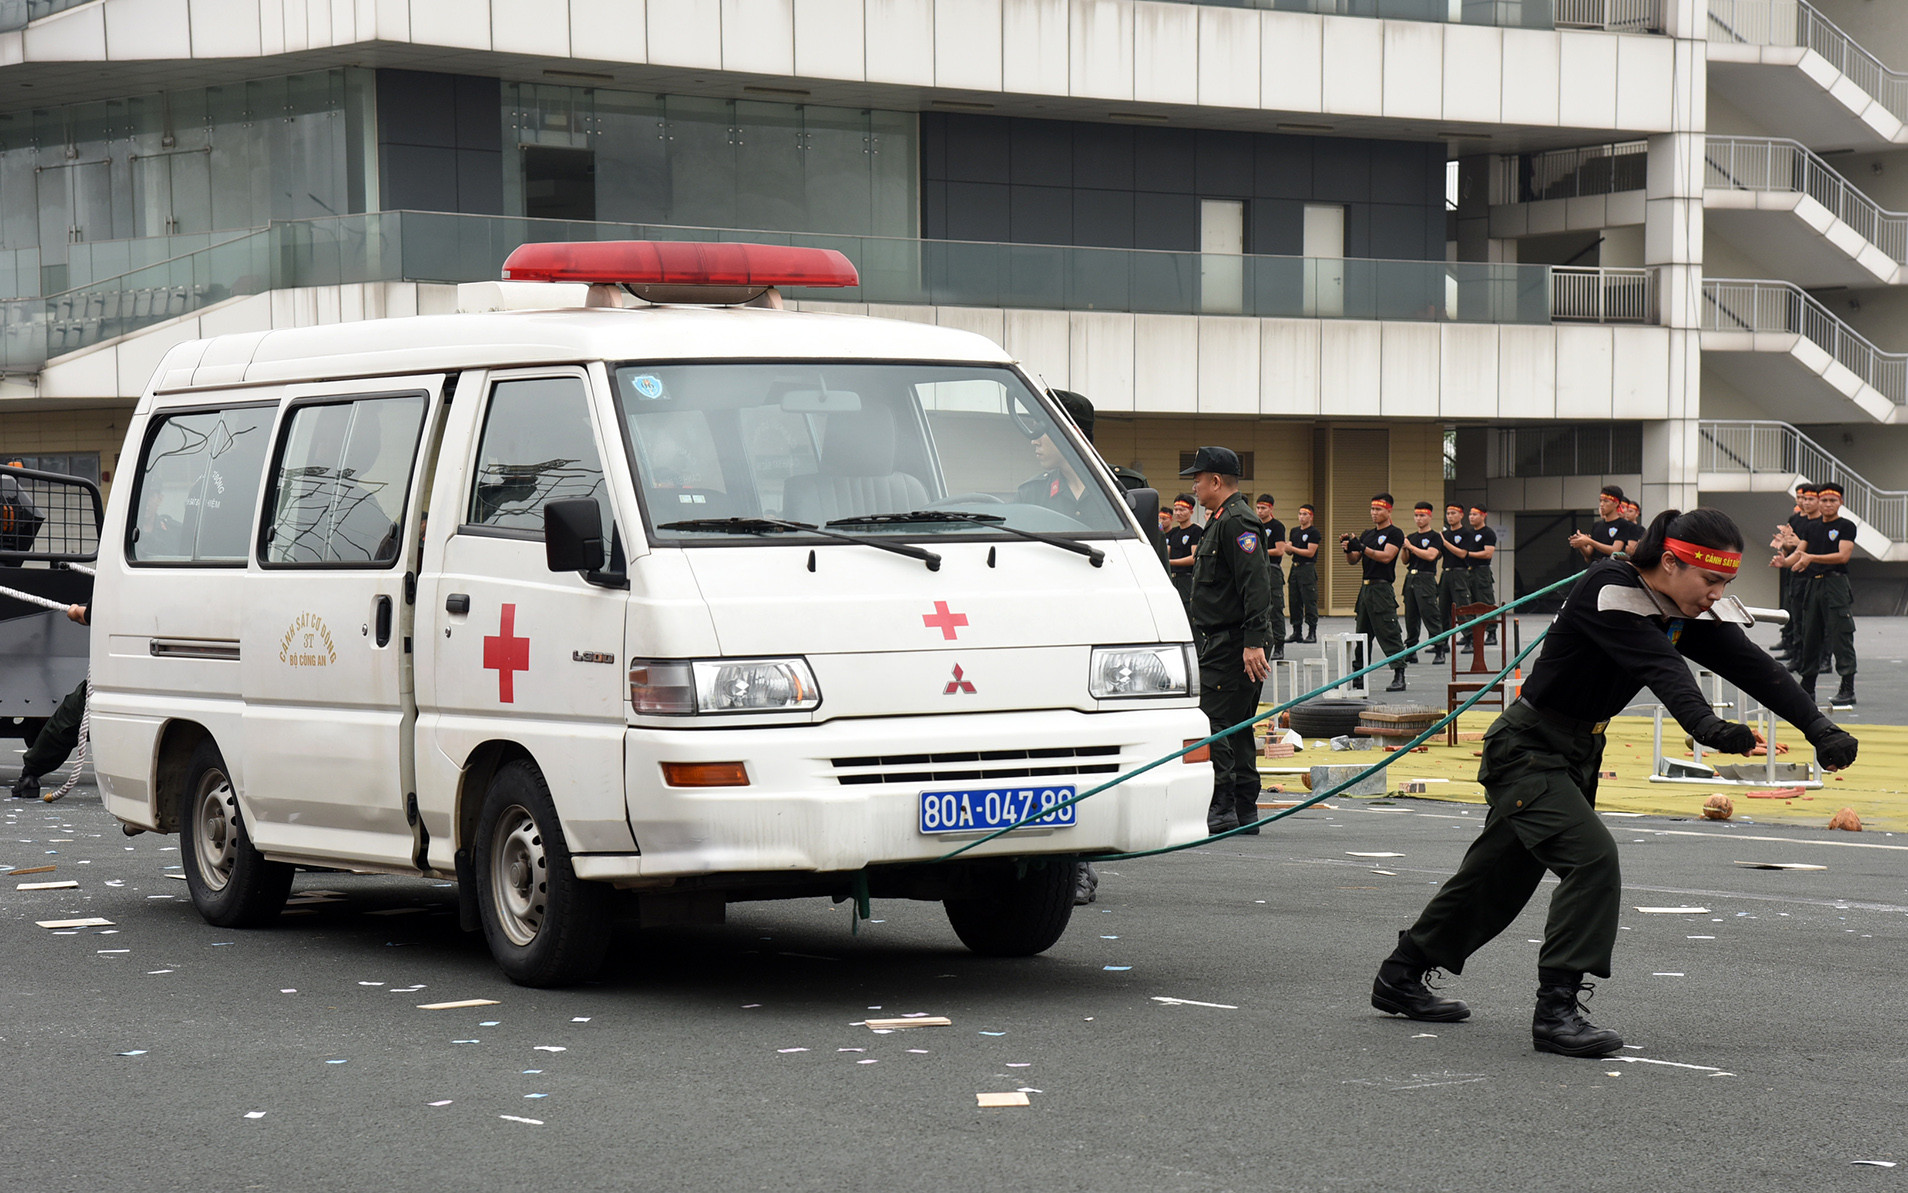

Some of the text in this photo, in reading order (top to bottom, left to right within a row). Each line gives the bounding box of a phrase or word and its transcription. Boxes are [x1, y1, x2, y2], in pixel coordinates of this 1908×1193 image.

[1705, 553, 1722, 566] CẢNH
[1722, 557, 1733, 567] SÁT
[280, 623, 295, 663] CẢNH
[296, 610, 309, 631] SÁT
[311, 613, 322, 631] CƠ
[289, 652, 327, 668] BỘ CÔNG AN
[572, 650, 615, 664] L300
